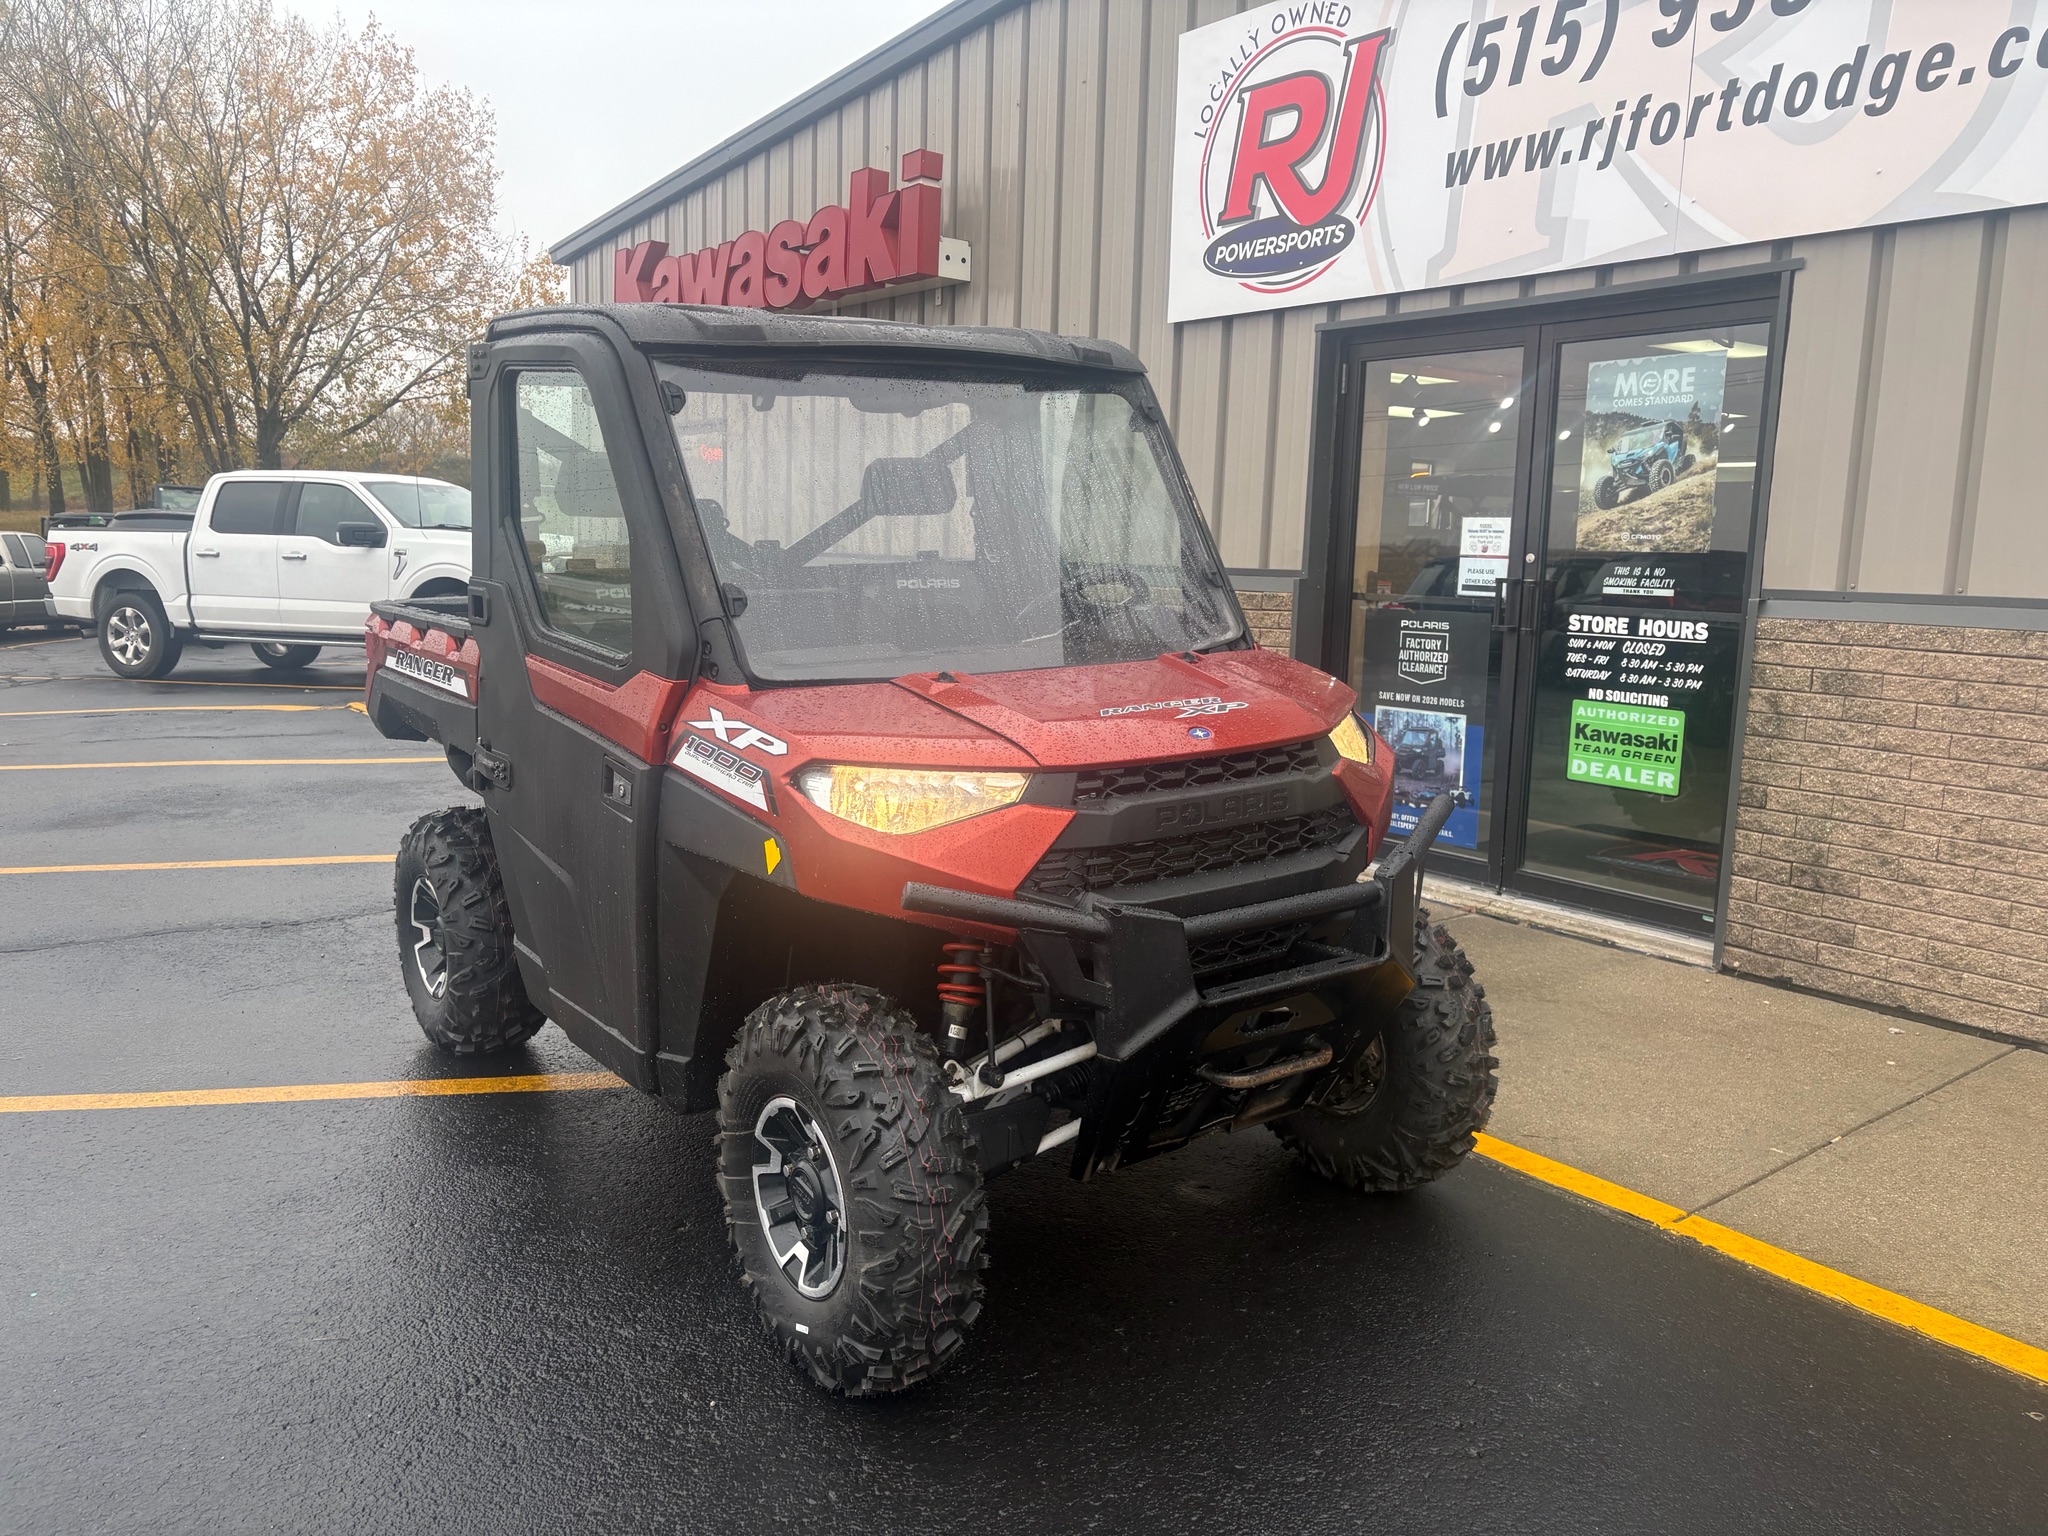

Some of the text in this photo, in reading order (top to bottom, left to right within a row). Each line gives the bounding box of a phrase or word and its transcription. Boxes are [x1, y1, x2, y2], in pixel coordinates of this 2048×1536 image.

[1194, 1, 1352, 138] LOCALLY OWNED
[1435, 0, 1621, 118] (515)
[1217, 27, 1395, 226] RJ
[614, 148, 943, 308] Kawasaki
[1215, 223, 1346, 264] POWERSPORTS
[1613, 366, 1696, 397] MORE
[1613, 394, 1694, 408] COMES STANDARD
[1614, 566, 1666, 577] THIS IS A NO
[896, 579, 960, 589] POLARIS
[1603, 577, 1675, 588] SMOKING FACILITY
[1401, 620, 1450, 630] POLARIS
[1568, 614, 1709, 640] STORE HOURS
[1406, 638, 1441, 650] FACTORY
[1568, 638, 1587, 648] SUN
[1593, 640, 1616, 650] MON
[1622, 641, 1666, 656] CLOSED
[1399, 650, 1448, 663] AUTHORIZED
[1566, 652, 1587, 663] TUES
[1593, 655, 1610, 665] FRI
[1640, 659, 1659, 670] AM
[1685, 663, 1704, 674] PM
[395, 649, 454, 686] RANGER
[1402, 662, 1444, 674] CLEARANCE
[1565, 668, 1612, 680] SATURDAY
[1639, 675, 1657, 685] AM
[1684, 679, 1703, 690] PM
[1100, 697, 1222, 717] RANGER
[1379, 691, 1465, 708] SAVE NOW ON 2026 MODELS
[1588, 688, 1669, 707] NO SOLICITING
[1174, 702, 1249, 719] XP
[1577, 706, 1679, 727] AUTHORIZED
[683, 705, 788, 756] XP
[1574, 723, 1678, 752] Kawasaki
[685, 735, 763, 784] 1000
[1574, 743, 1677, 764] TEAM GREEN
[684, 751, 755, 789] DUAL OVERHEAD CAM
[1571, 759, 1675, 788] DEALER
[1155, 788, 1289, 832] POLARIS
[1401, 814, 1419, 824] OFFERS
